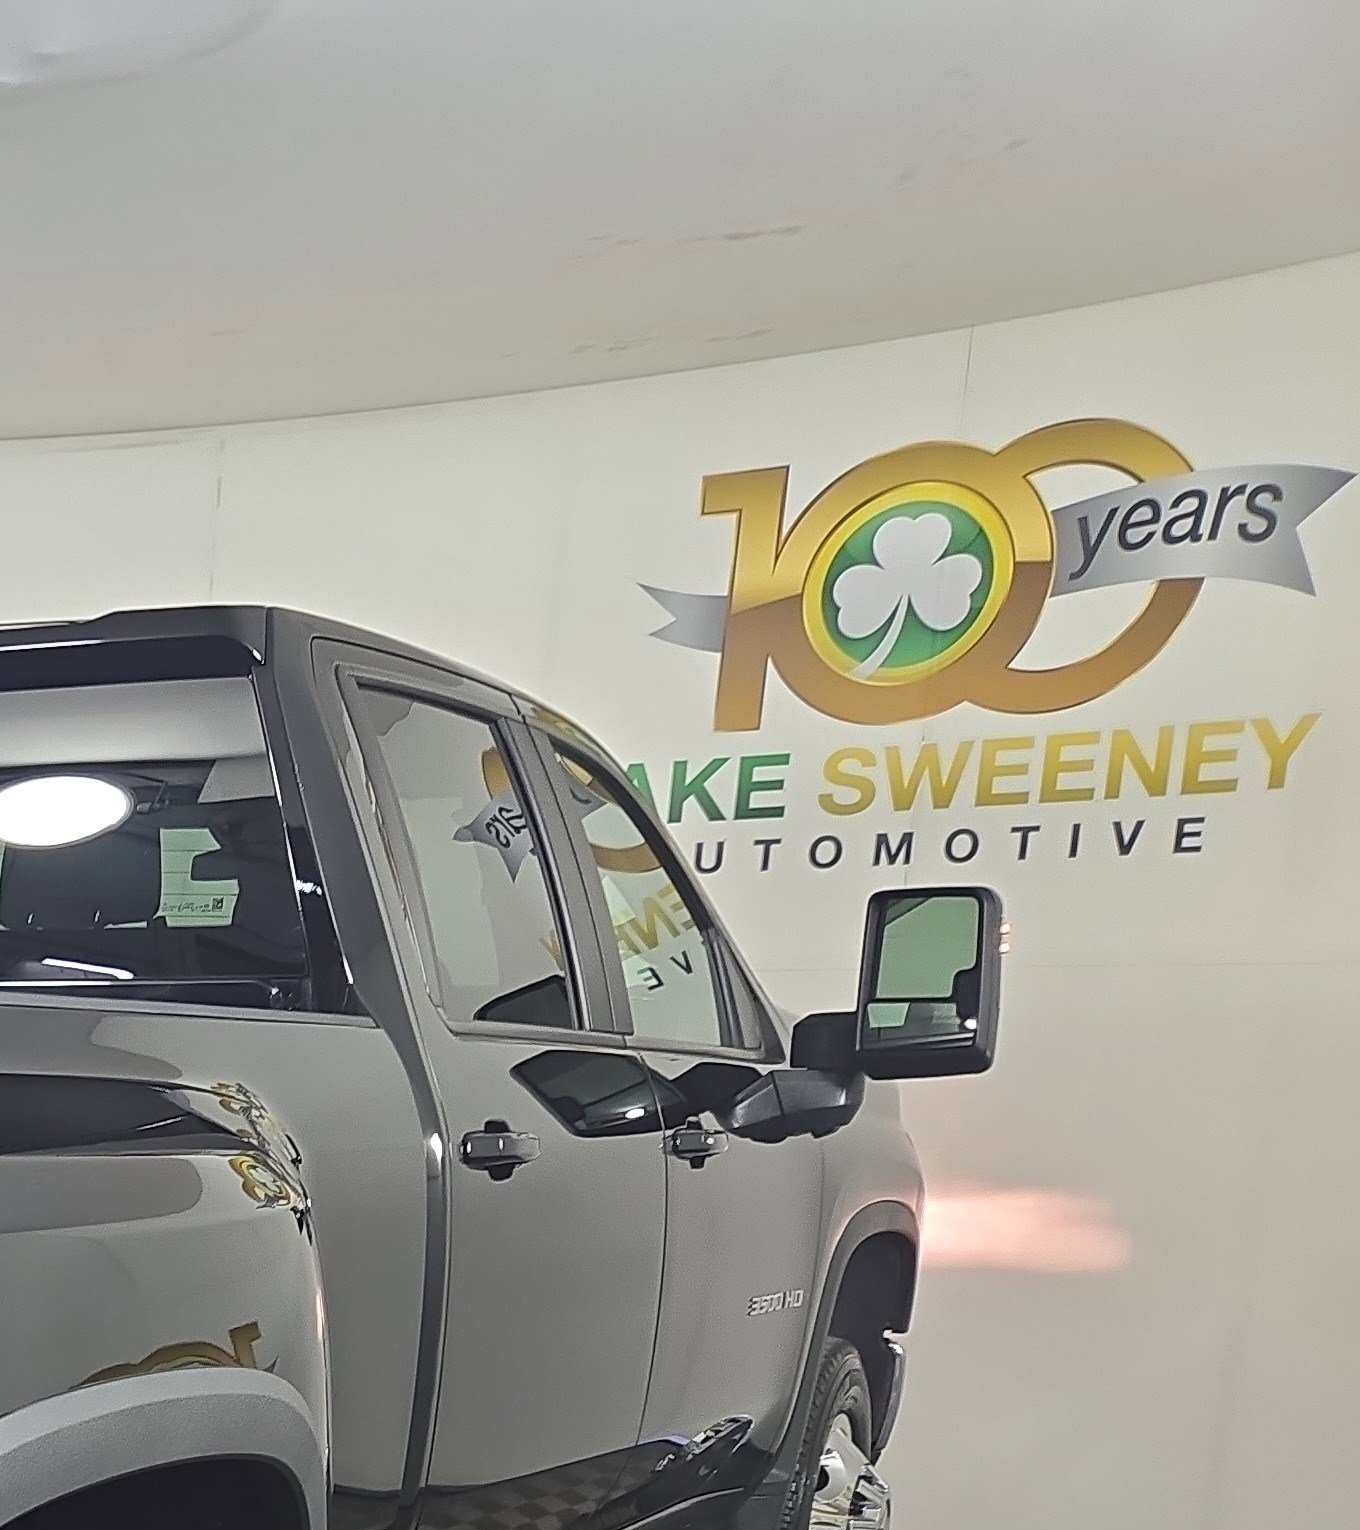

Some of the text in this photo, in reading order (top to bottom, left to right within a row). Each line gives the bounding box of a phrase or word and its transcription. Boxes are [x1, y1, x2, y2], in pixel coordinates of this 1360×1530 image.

[701, 417, 1205, 733] 100
[1068, 480, 1285, 582] years
[626, 712, 1322, 824] AKE SWEENEY
[693, 816, 1207, 875] UTOMOTIVE
[784, 1289, 804, 1309] HD
